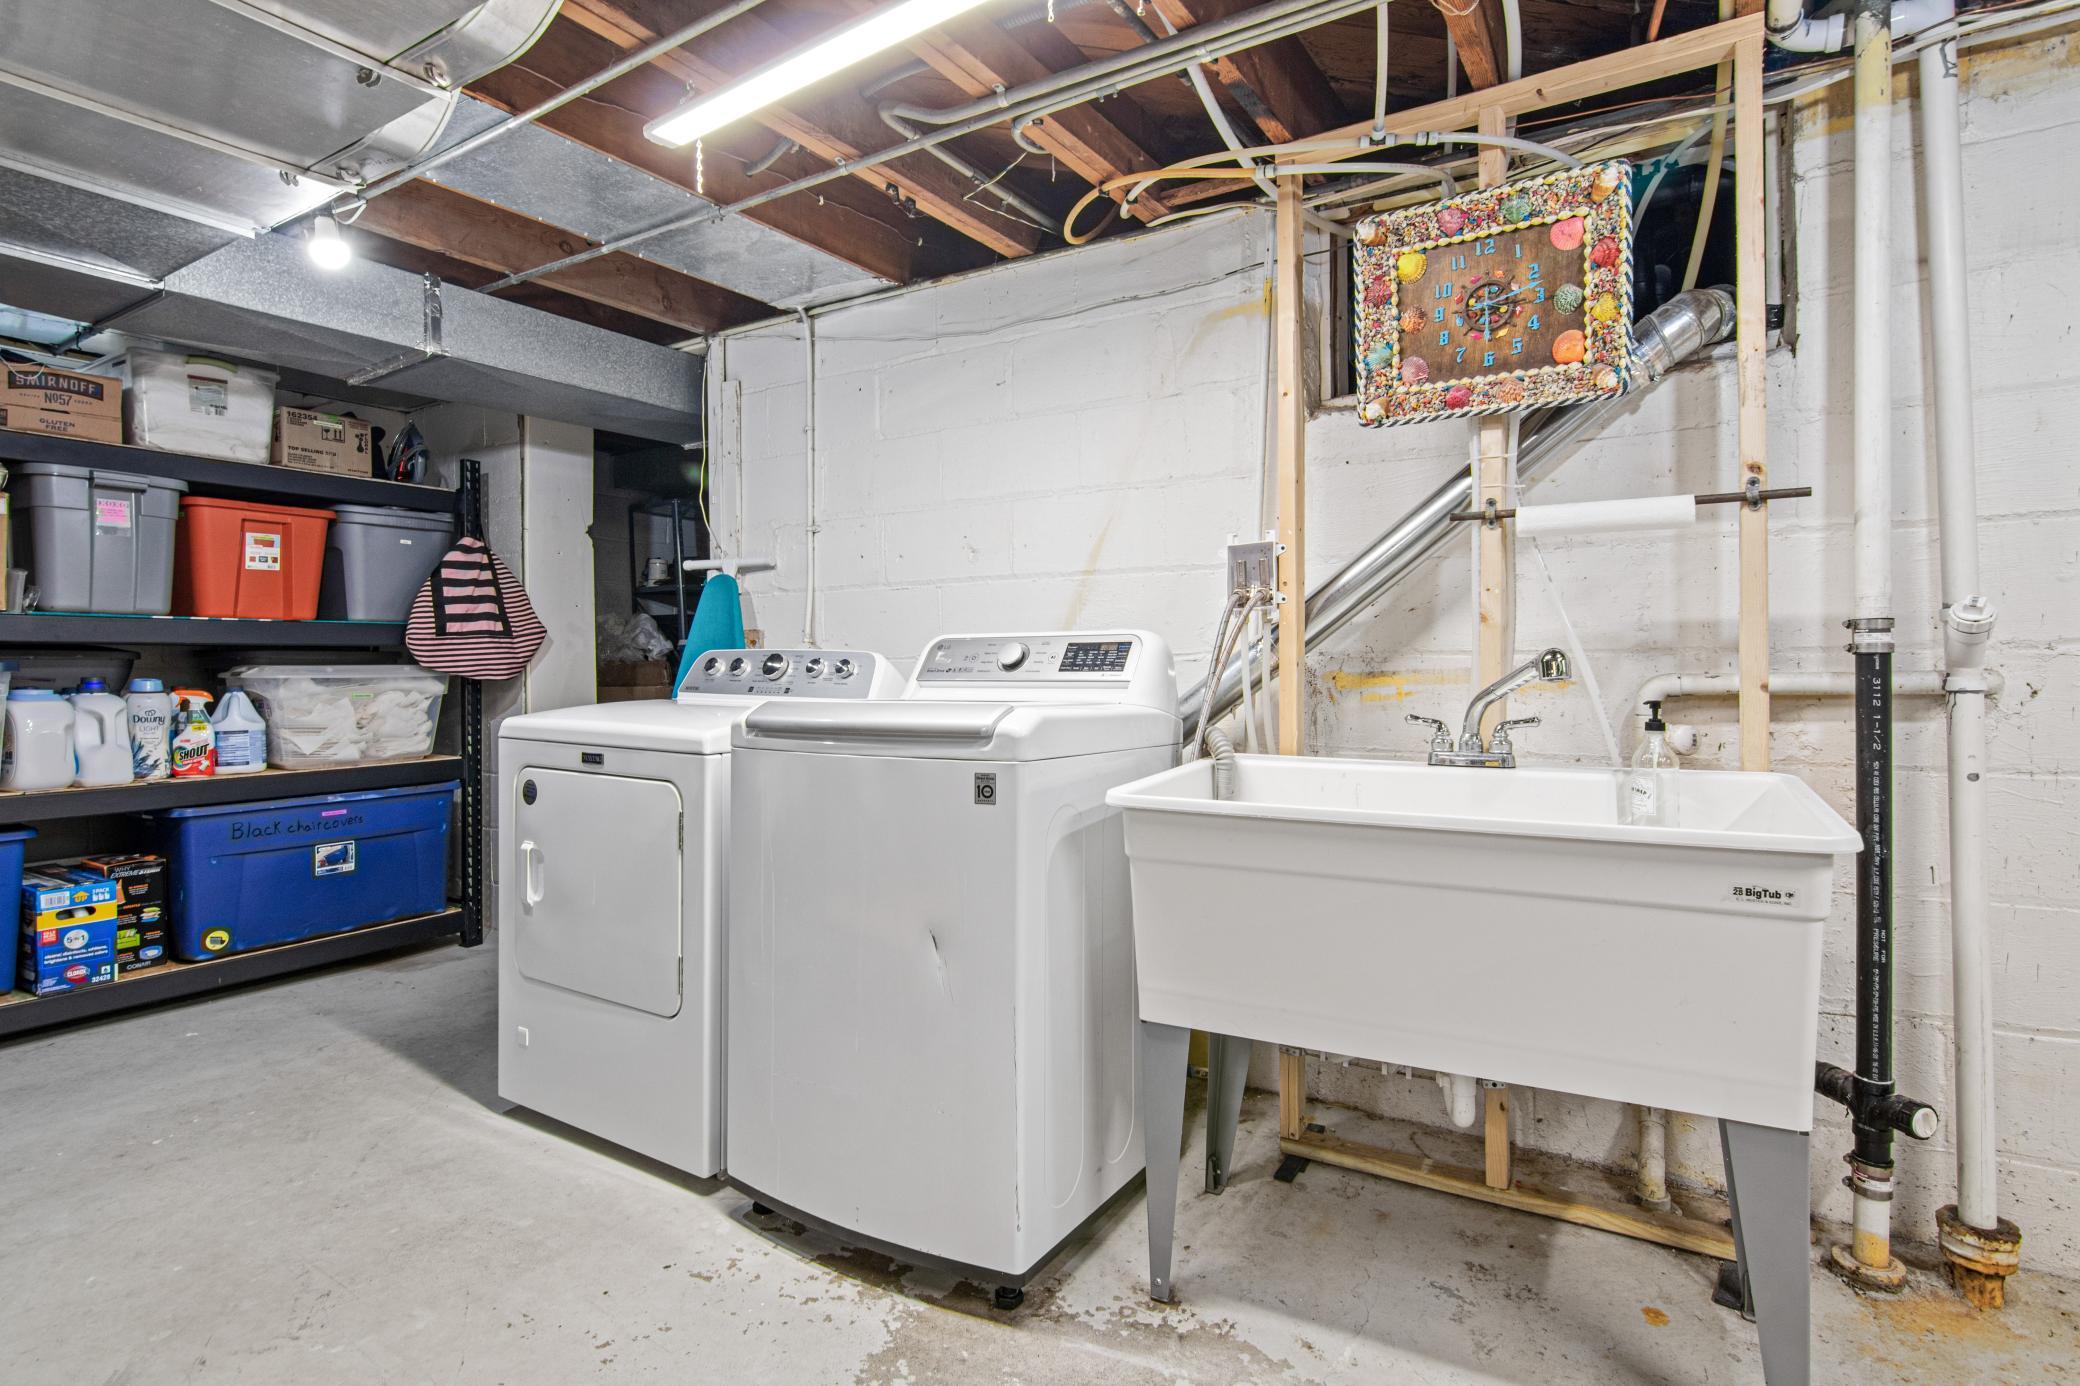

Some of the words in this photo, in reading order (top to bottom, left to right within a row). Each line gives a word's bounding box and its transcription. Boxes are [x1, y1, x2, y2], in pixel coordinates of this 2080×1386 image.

[1475, 239, 1496, 257] 12
[1515, 243, 1522, 258] 1
[1451, 255, 1466, 271] 11
[1528, 263, 1540, 280] 2
[1435, 281, 1453, 299] 10
[1533, 287, 1545, 304] 3
[1434, 306, 1445, 323] 9
[1528, 314, 1540, 330] 4
[1439, 330, 1450, 346] 8
[1511, 337, 1523, 355] 5
[1456, 346, 1467, 363] 7
[1483, 351, 1495, 367] 6
[15, 373, 97, 396] SMIRNOFF
[40, 418, 76, 428] GLUTEN
[45, 424, 69, 432] FREE
[1873, 677, 1881, 707] 3112
[132, 714, 166, 726] Downy
[1873, 714, 1882, 751] 1-1/2
[178, 743, 210, 760] SHOUT
[977, 785, 993, 798] 10
[231, 820, 281, 840] Black
[1745, 887, 1782, 900] BigTub
[126, 961, 152, 971] CONAIR
